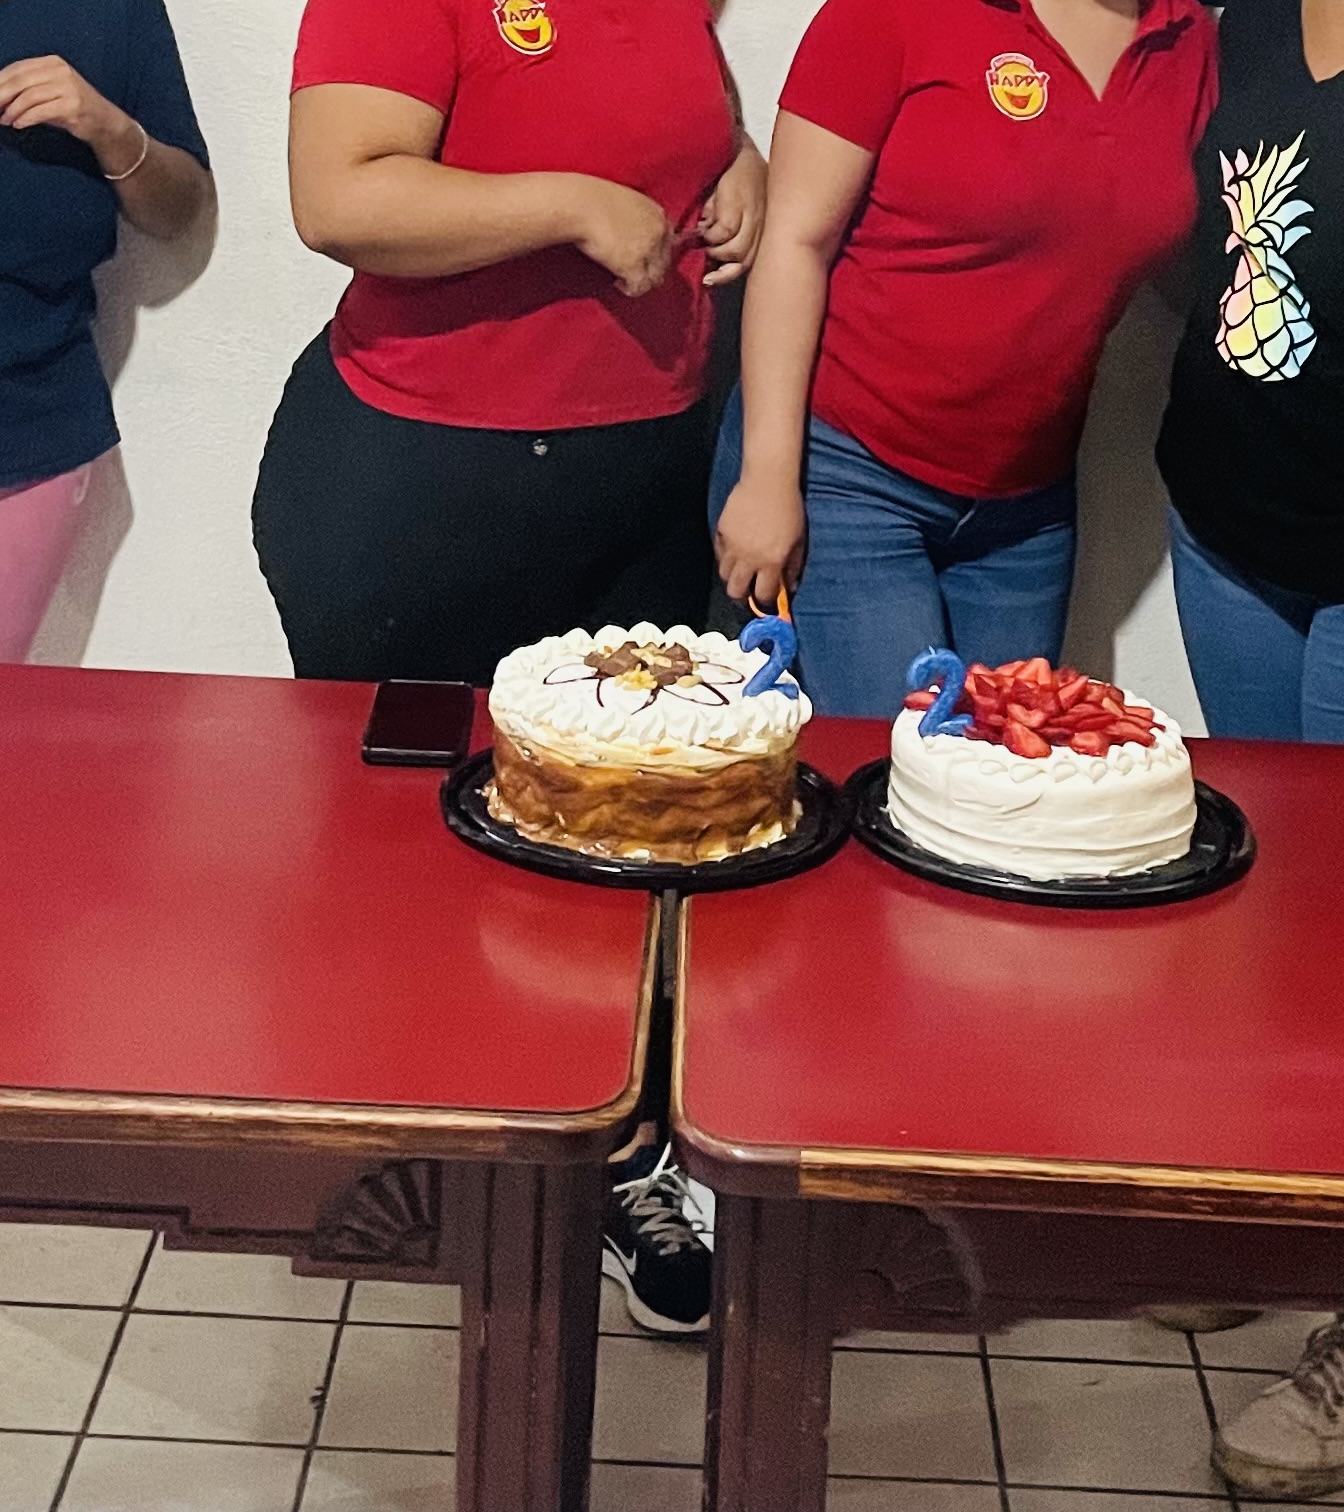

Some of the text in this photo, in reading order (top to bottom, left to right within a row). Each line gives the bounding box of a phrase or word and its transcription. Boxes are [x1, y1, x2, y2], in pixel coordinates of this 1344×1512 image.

[988, 72, 1049, 88] HAPPY
[739, 615, 800, 700] 2
[909, 646, 973, 737] 2
